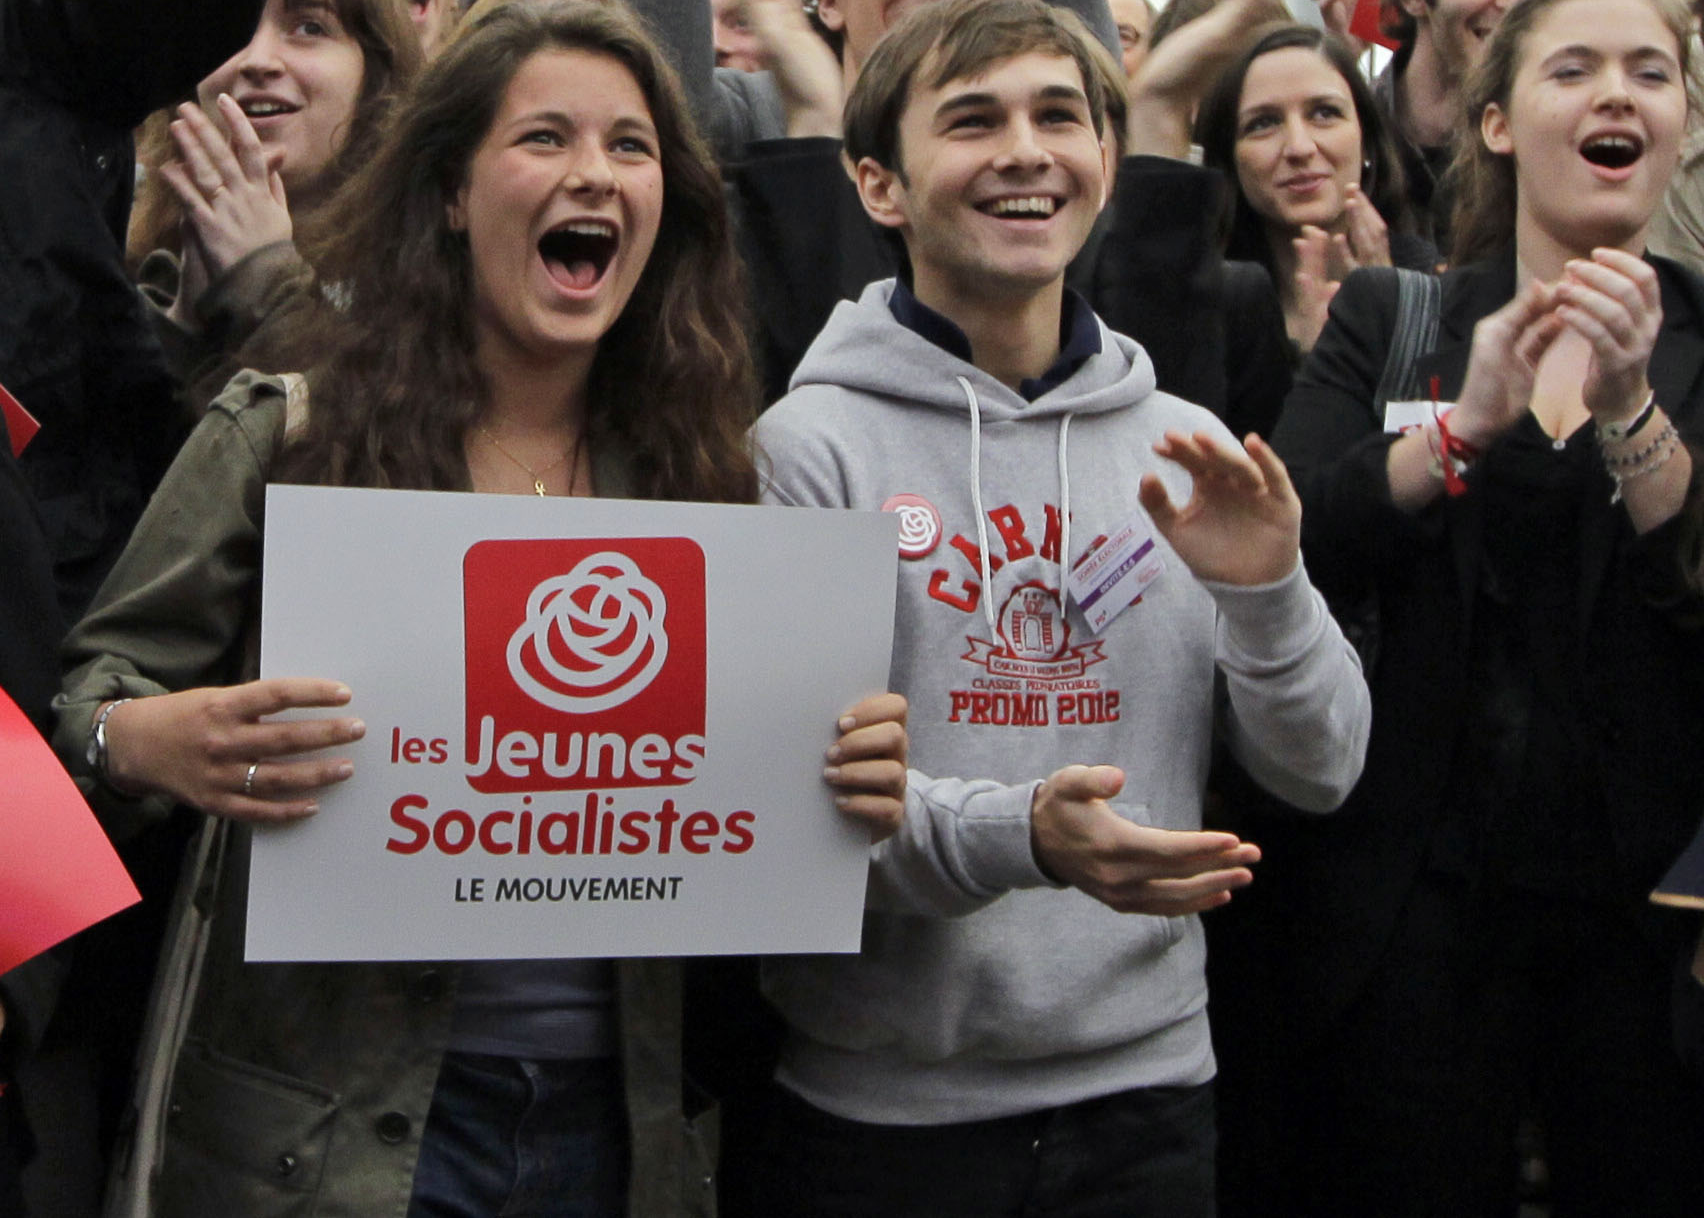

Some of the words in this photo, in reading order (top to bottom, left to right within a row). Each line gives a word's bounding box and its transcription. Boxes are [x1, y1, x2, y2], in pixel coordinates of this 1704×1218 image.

[948, 690, 1049, 727] PROMO
[1057, 690, 1120, 726] 2012
[390, 726, 449, 764] les
[466, 714, 706, 779] Jeunes
[386, 792, 756, 856] Socialistes
[454, 878, 485, 902] LE
[495, 876, 684, 902] MOUVEMENT
